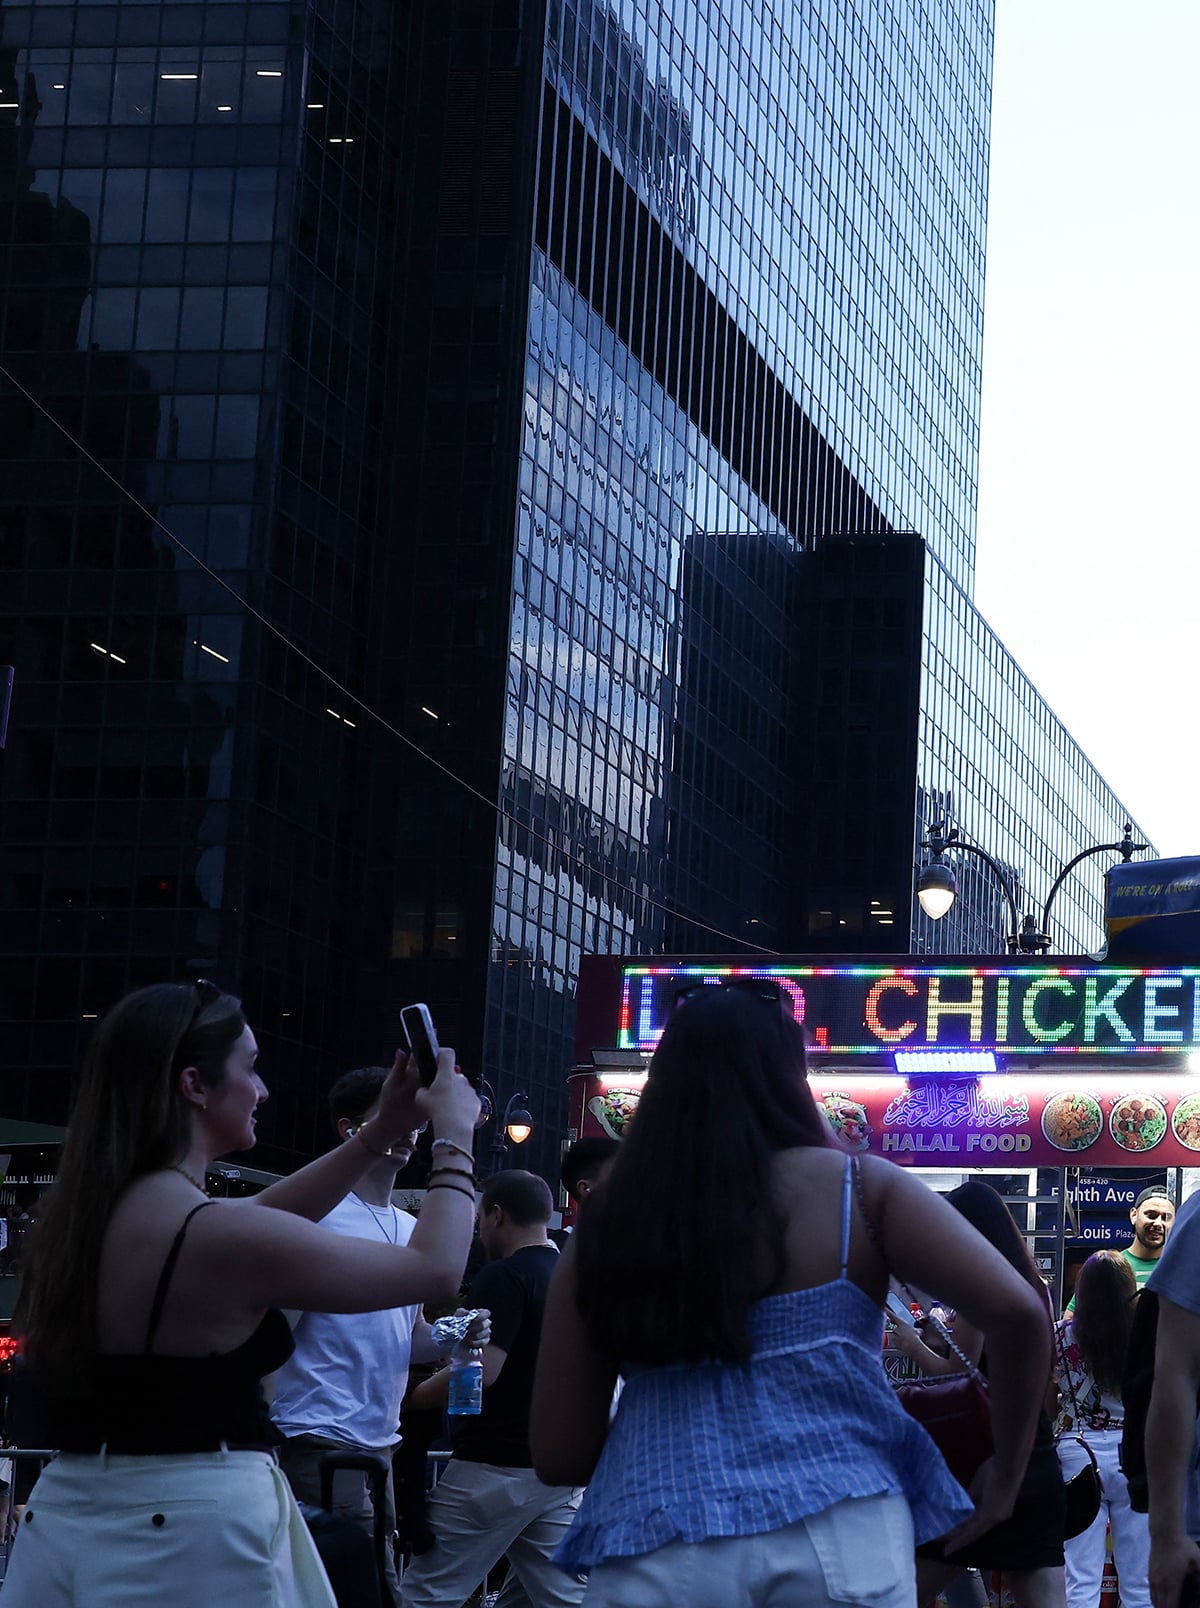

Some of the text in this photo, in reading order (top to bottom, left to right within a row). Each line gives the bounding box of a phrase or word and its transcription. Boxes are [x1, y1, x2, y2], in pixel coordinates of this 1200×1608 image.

[1116, 884, 1147, 896] WE'RE
[1148, 884, 1163, 896] ON
[1165, 883, 1172, 894] A
[1173, 880, 1192, 893] ROLL
[882, 1133, 1032, 1153] HALAL FOOD
[1051, 1186, 1135, 1204] Eghth Ave
